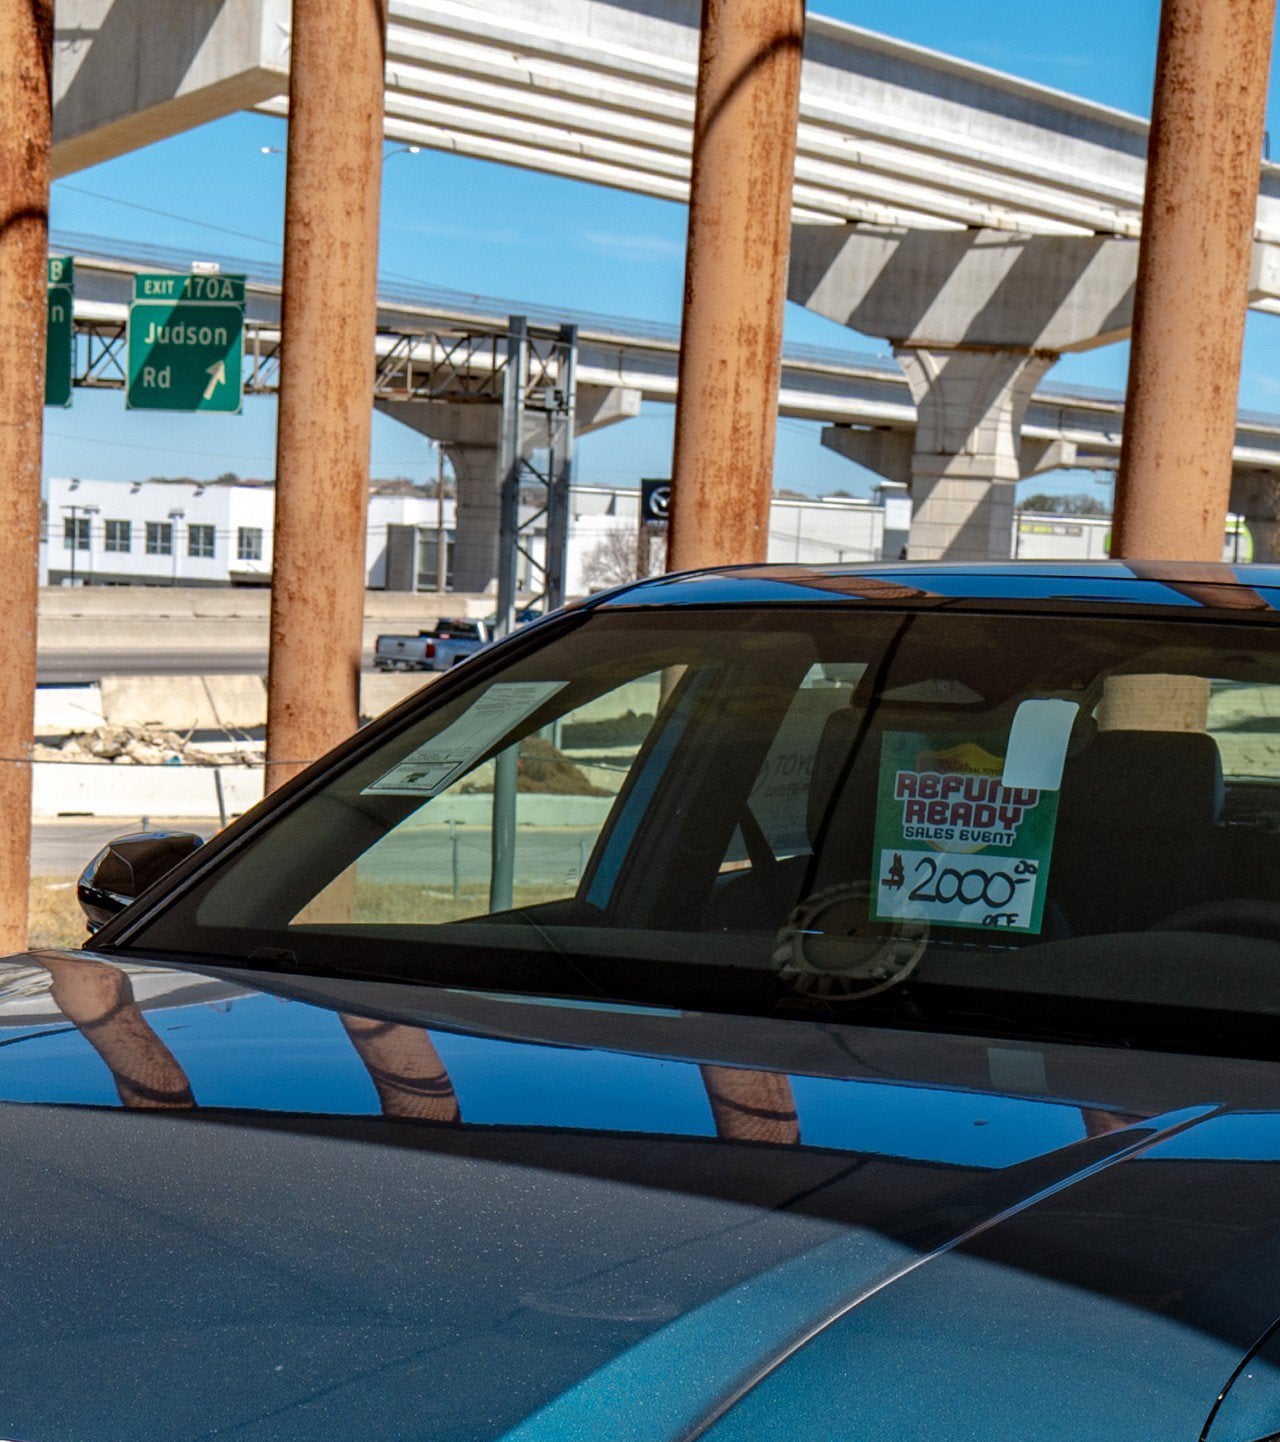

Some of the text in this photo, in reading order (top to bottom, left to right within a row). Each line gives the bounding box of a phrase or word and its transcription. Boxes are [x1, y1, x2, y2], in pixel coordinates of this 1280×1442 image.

[143, 278, 234, 299] EXIT 170A
[144, 322, 228, 346] Judson
[143, 366, 171, 388] Rd
[896, 772, 1039, 806] REFUND
[904, 800, 1023, 831] READY
[905, 826, 1015, 846] SALES EVENT
